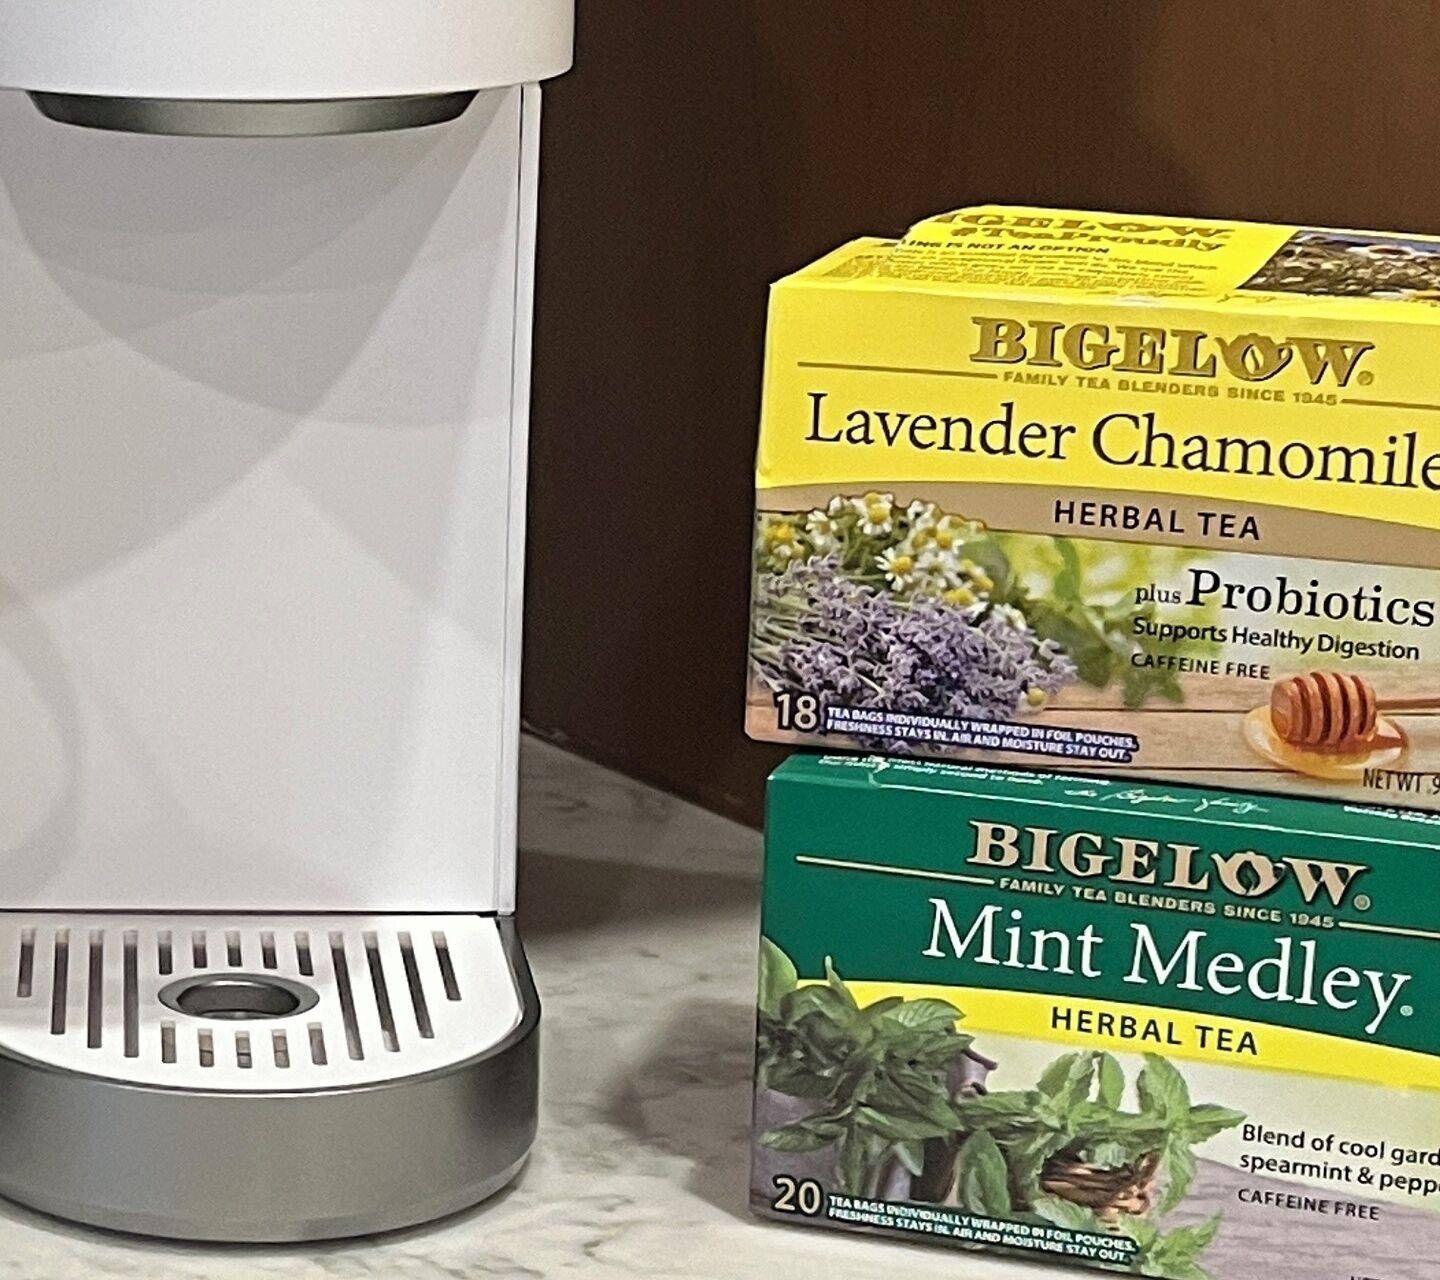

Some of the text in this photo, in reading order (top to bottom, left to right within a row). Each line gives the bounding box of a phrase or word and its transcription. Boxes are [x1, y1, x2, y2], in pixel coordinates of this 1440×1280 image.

[970, 316, 1375, 387] BIGELOW
[1003, 371, 1339, 406] FAMILY TEA BLENDERS SINCE 1945
[805, 392, 1440, 491] Lavender Chamomile
[1054, 500, 1261, 541] HERBAL TEA
[1135, 568, 1436, 628] plus Probiotics
[1133, 616, 1420, 661] Supports Healthy Digestion
[1131, 653, 1271, 681] CAFFEINE FREE
[777, 693, 817, 729] 18
[827, 707, 850, 719] TEA
[852, 710, 883, 723] BAGS
[886, 713, 968, 732] INDIVIDUALLY
[971, 721, 1030, 738] WRAPPED
[1046, 729, 1073, 742] FOIL
[826, 719, 893, 736] FRESHNESS
[894, 726, 931, 740] STAYS
[973, 734, 1000, 747] AND
[1002, 737, 1063, 754] MOISTURE
[1066, 744, 1097, 757] STAY
[1363, 767, 1393, 791] NET
[1396, 771, 1423, 793] WT
[967, 820, 1369, 907] BIGELOW
[999, 878, 1335, 929] FAMILY TEA BLENDERS SINCE 1945
[922, 898, 1412, 1035] Mint Medley
[1051, 1006, 1259, 1056] HERBAL TEA
[1242, 1124, 1305, 1149] Blend
[1310, 1134, 1335, 1152] of
[1338, 1141, 1385, 1159] cool
[1240, 1153, 1352, 1182] spearmint
[1357, 1166, 1375, 1185] &
[774, 1177, 821, 1215] 20
[1237, 1188, 1380, 1221] CAFFEINE FREE
[829, 1195, 852, 1209] TEA
[972, 1218, 1030, 1236] WRAPPED
[1047, 1229, 1073, 1243] FOIL
[896, 1218, 933, 1233] STAYS
[974, 1230, 1001, 1243] AND
[1002, 1234, 1063, 1253] MOISTURE
[1066, 1244, 1097, 1257] STAY
